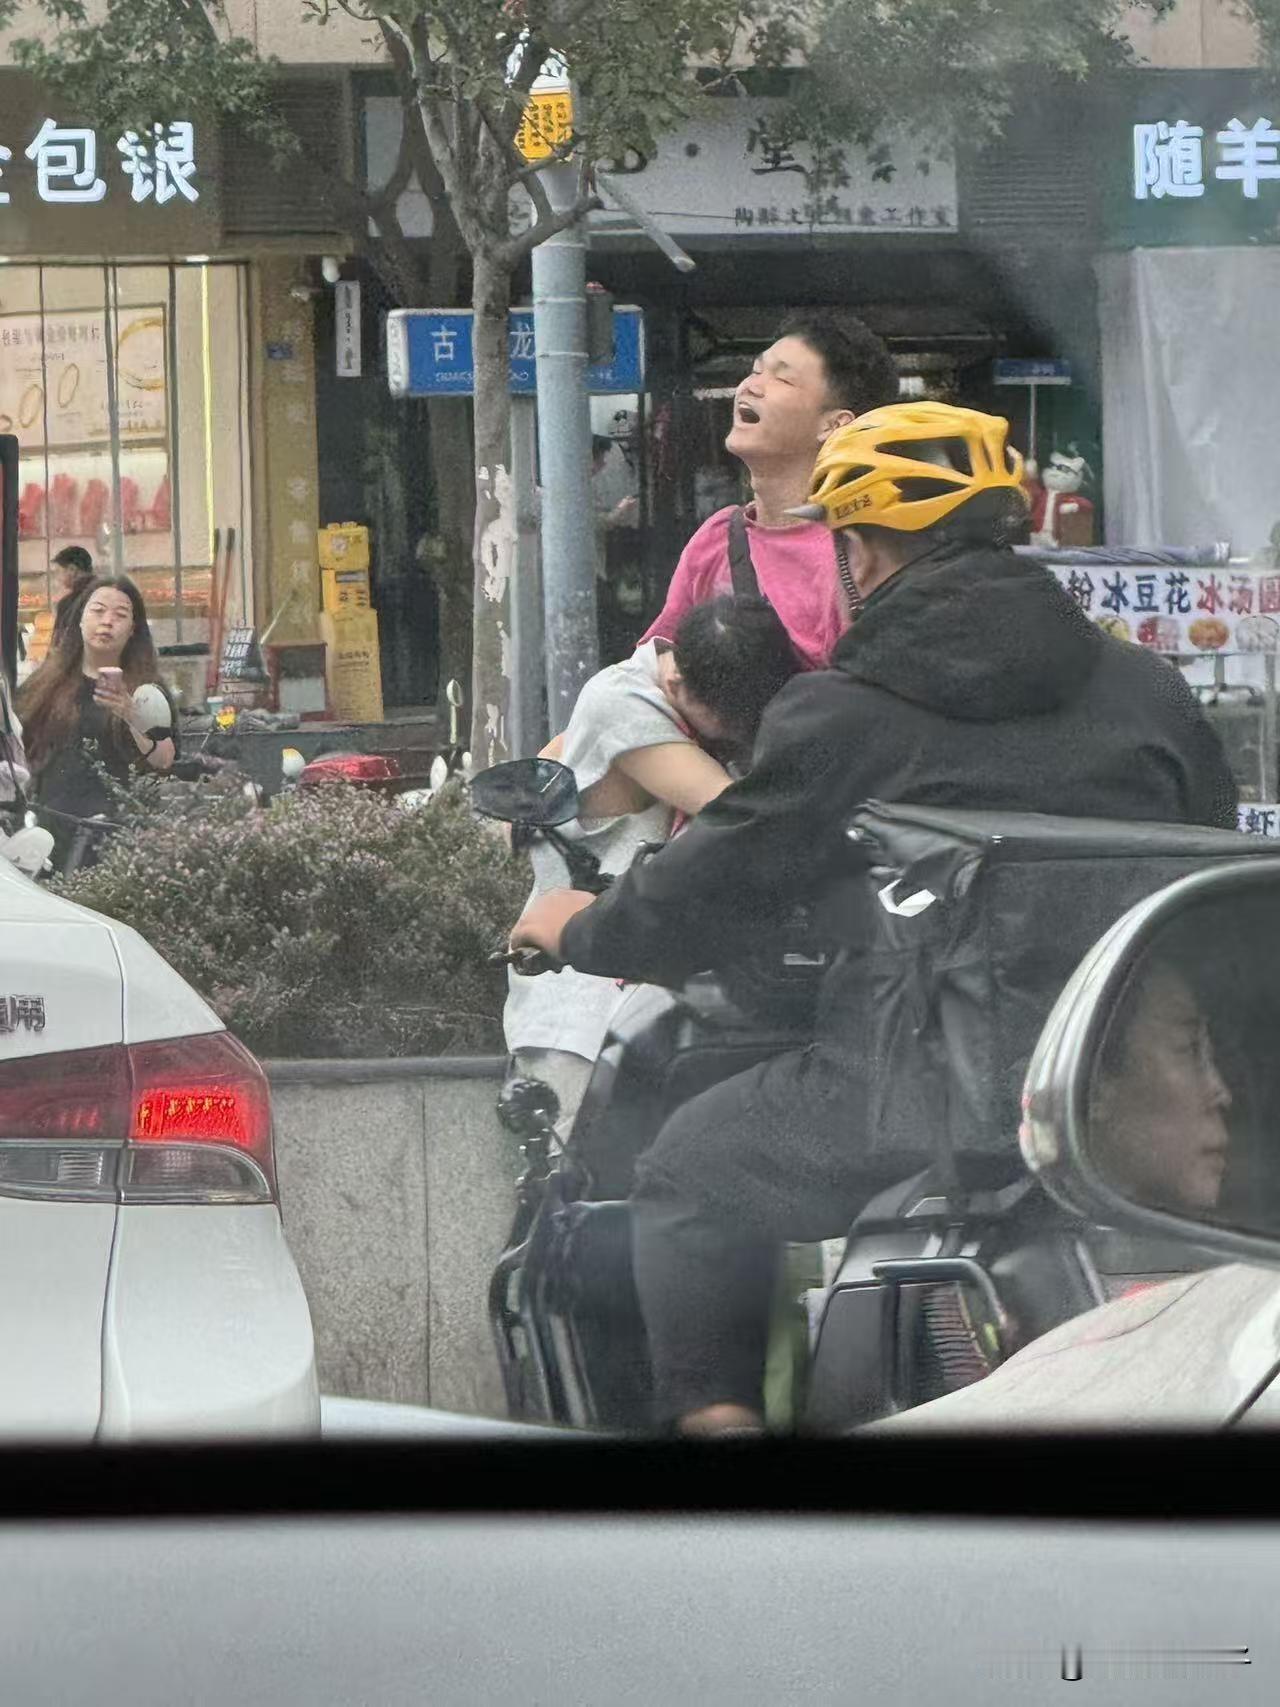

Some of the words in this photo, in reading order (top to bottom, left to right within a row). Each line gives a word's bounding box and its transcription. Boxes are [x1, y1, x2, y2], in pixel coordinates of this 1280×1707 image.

[0, 117, 200, 204] 包银
[1134, 117, 1280, 200] 随羊
[431, 324, 457, 363] 古
